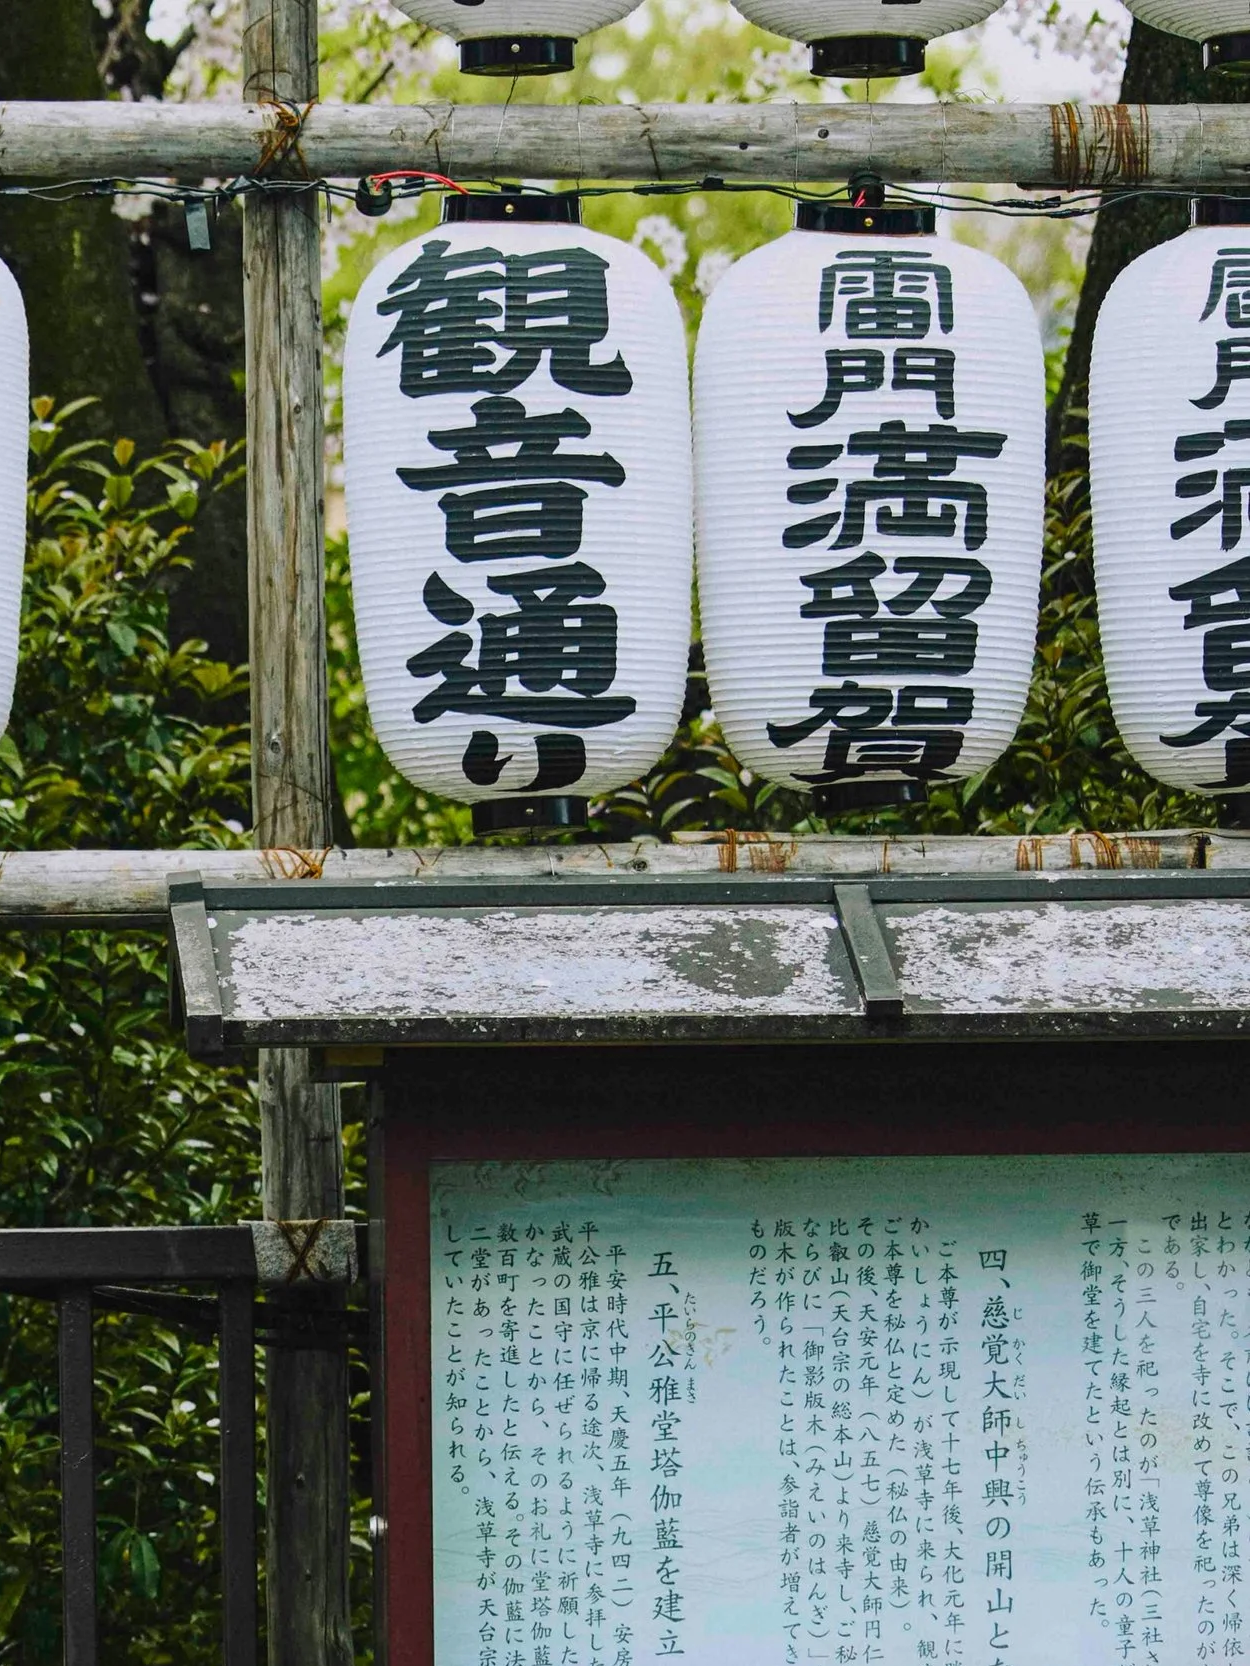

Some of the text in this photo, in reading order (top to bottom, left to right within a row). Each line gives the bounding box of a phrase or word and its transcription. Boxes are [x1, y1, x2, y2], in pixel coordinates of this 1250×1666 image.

[376, 240, 637, 792] 観音通り
[767, 250, 1008, 784] 雷門満留賀
[443, 1224, 470, 1495] していたことが知られる。
[647, 1251, 686, 1657] 五、平公雅堂塔伽藍を建立
[748, 1218, 772, 1346] ものだろう。
[882, 1216, 912, 1632] ご本尊を秘仏と定めた（秘仏の由来）。
[1079, 1211, 1110, 1628] 草で御堂を建てたという伝承もあった。
[1160, 1213, 1185, 1291] である。
